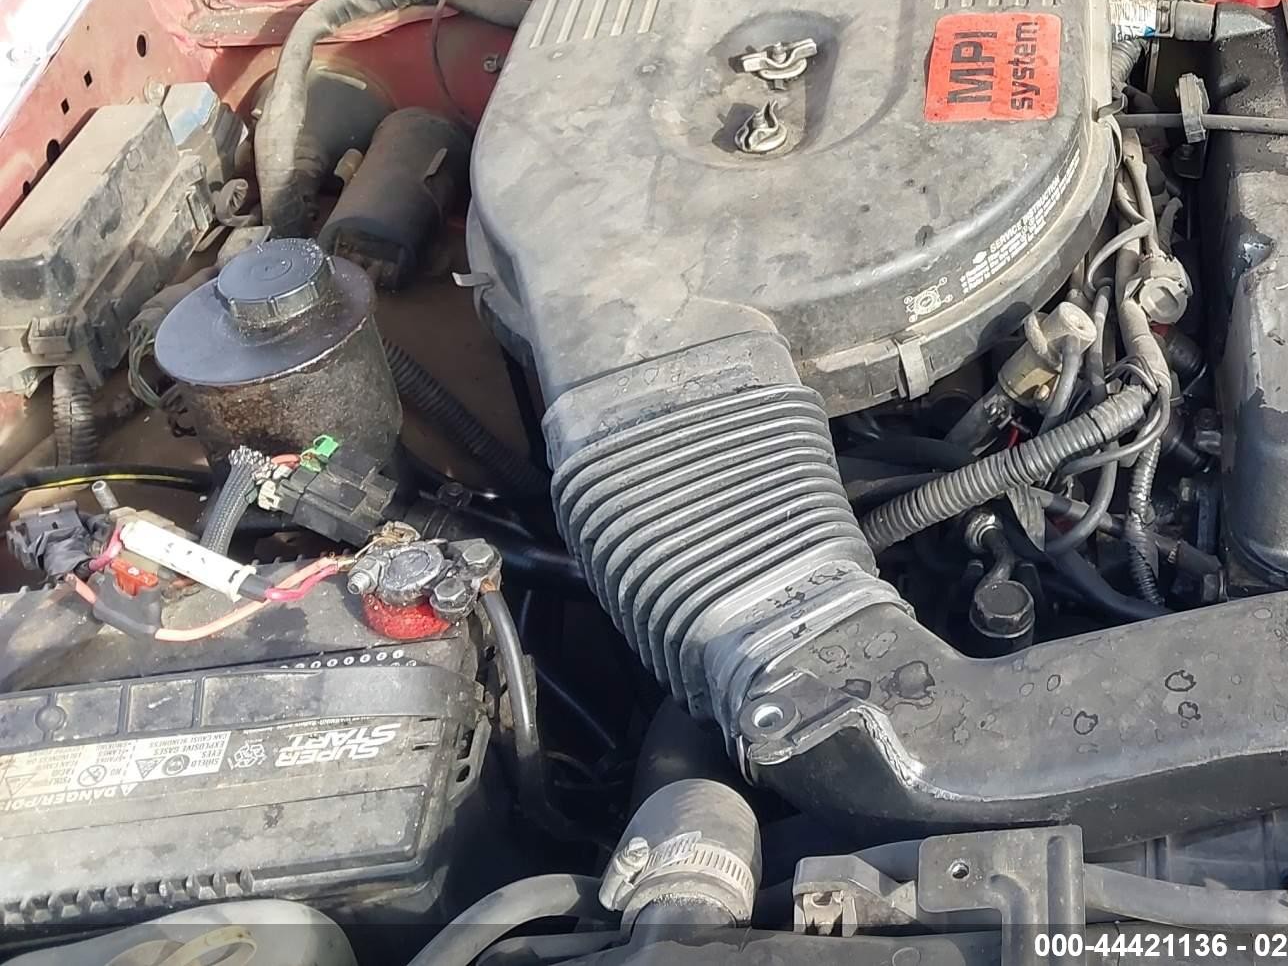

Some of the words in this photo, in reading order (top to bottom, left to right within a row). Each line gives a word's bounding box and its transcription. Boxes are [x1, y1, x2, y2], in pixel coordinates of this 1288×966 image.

[947, 31, 998, 104] MPI
[1010, 20, 1040, 111] system
[989, 217, 1023, 252] SERVICE
[183, 741, 225, 752] EXPLOSIVE
[289, 723, 401, 749] START
[190, 757, 219, 768] SHIELD
[275, 743, 379, 767] SUPER
